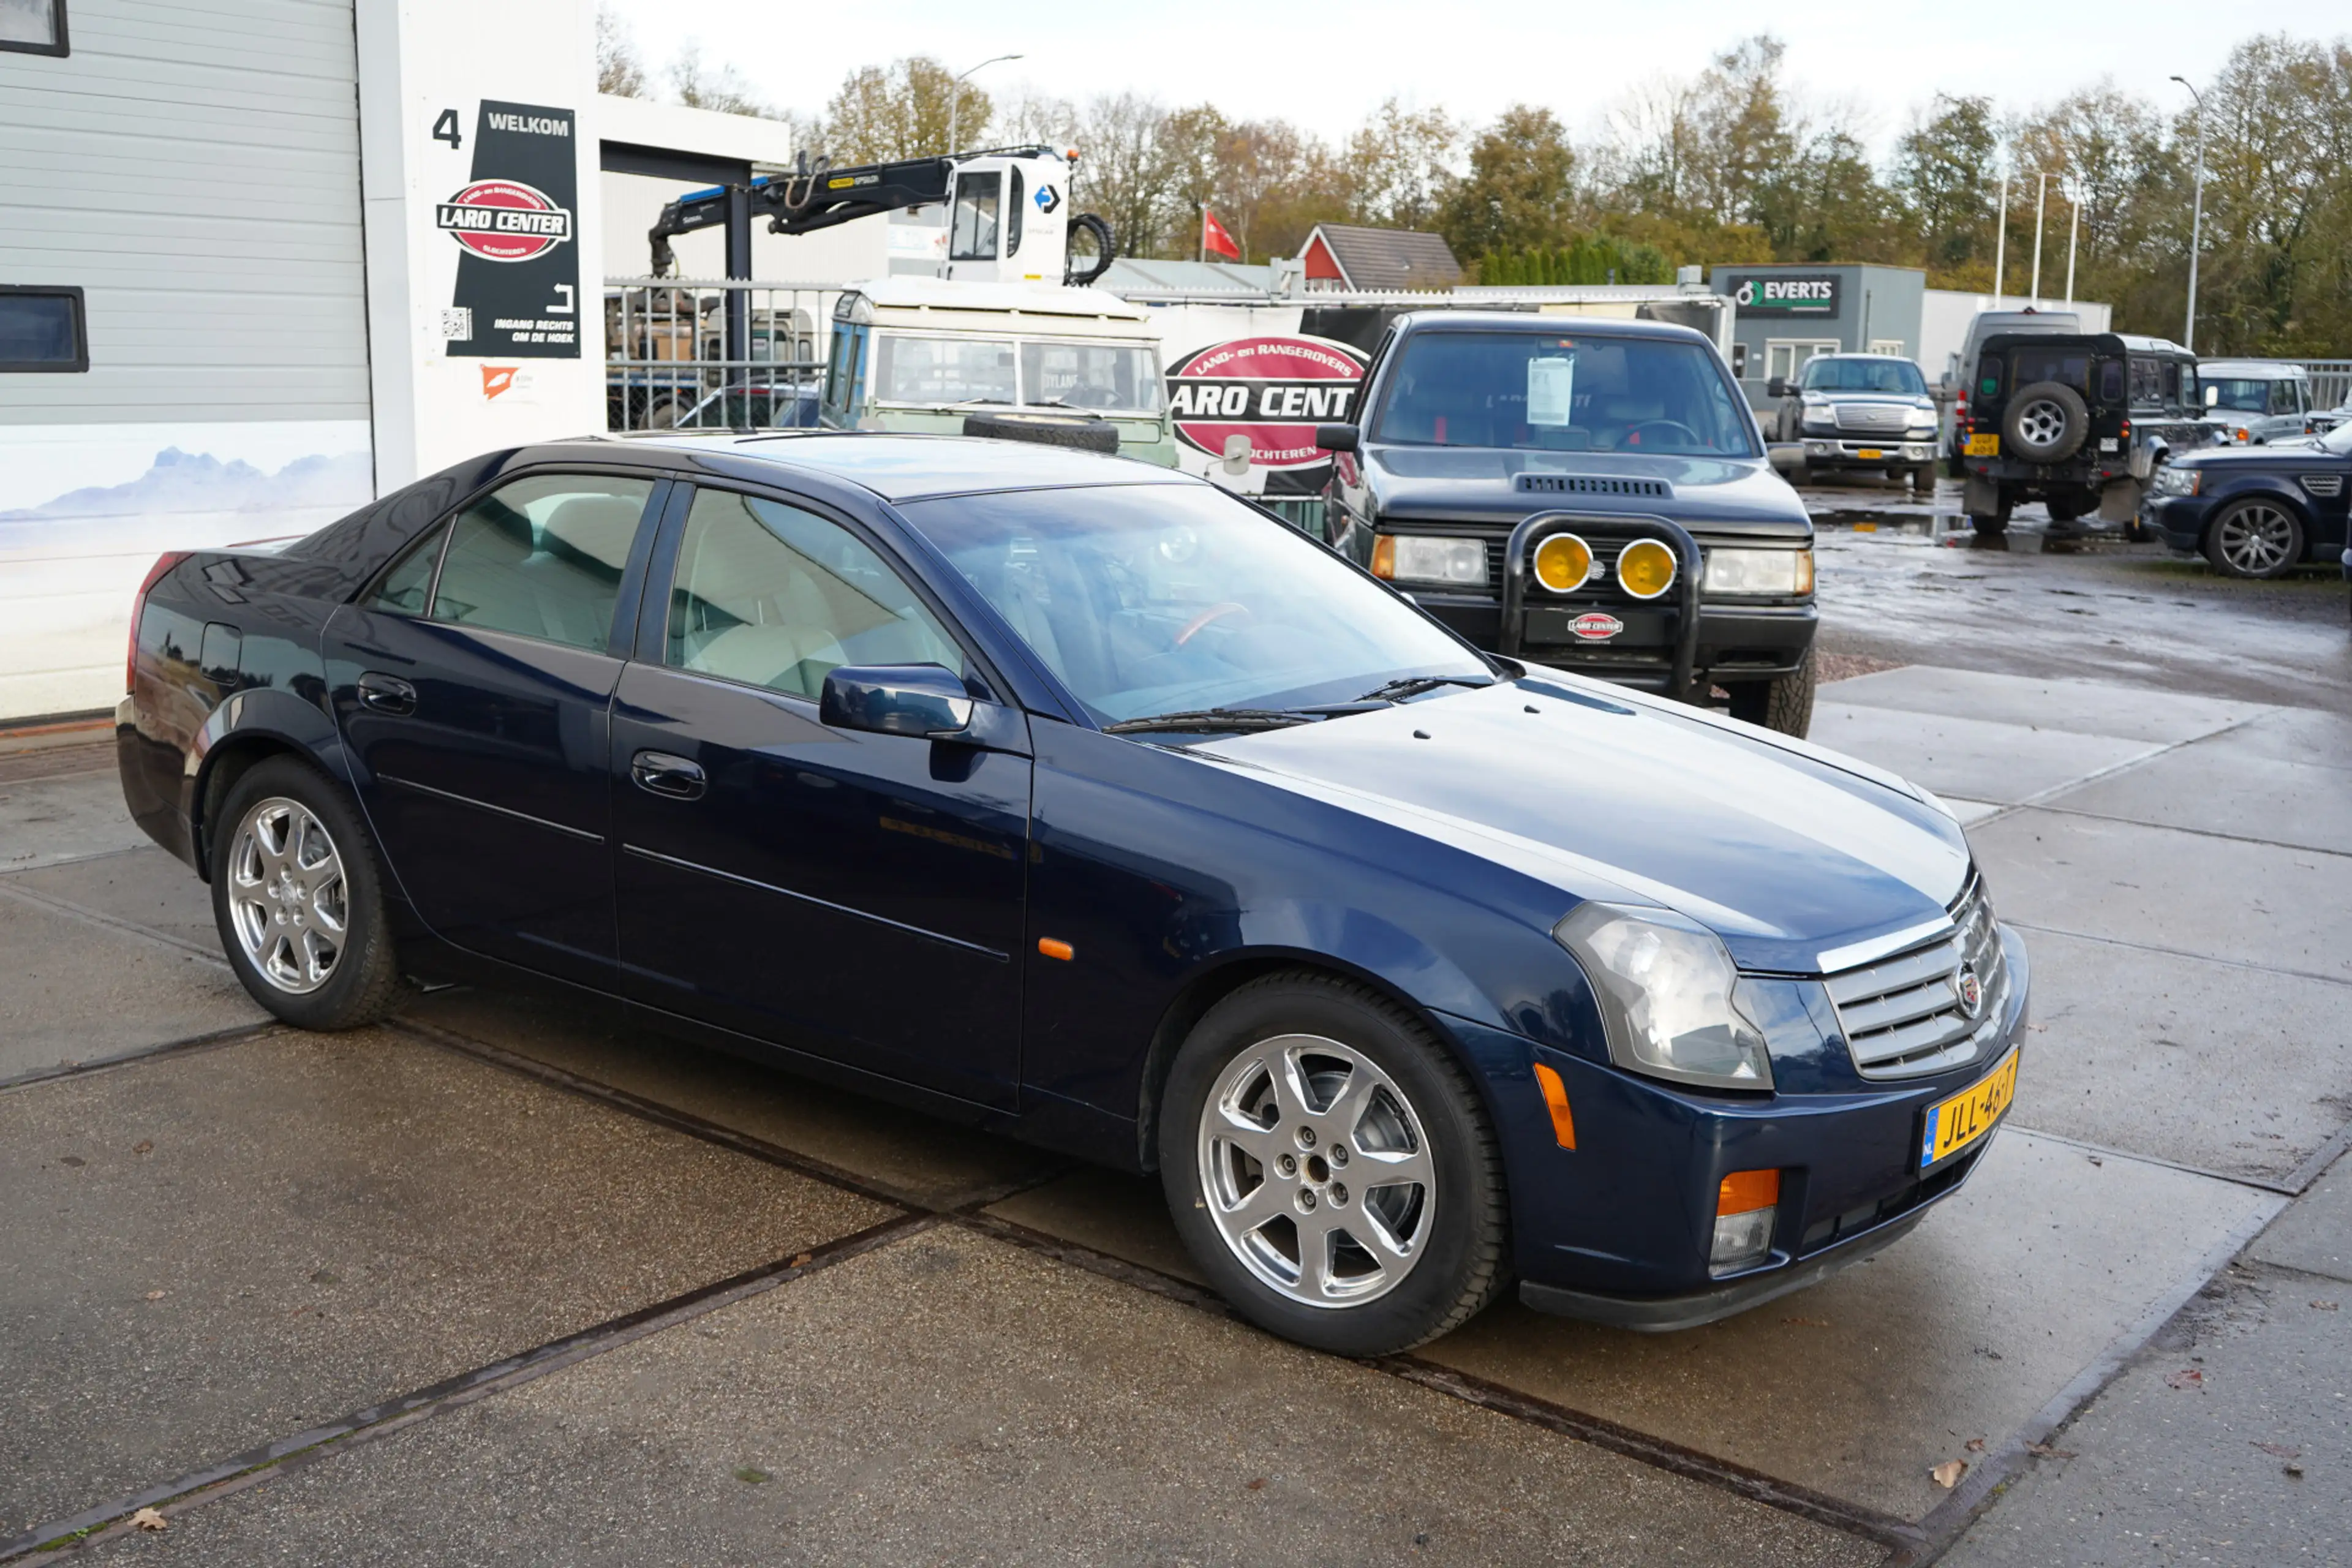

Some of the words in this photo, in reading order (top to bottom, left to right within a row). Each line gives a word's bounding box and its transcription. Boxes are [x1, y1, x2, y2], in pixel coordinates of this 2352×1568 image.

[432, 108, 461, 149] 4
[488, 112, 569, 137] WELKOM
[440, 208, 492, 228] LARO
[496, 212, 564, 234] CENTER
[1765, 281, 1832, 299] EVERTS
[494, 318, 534, 330] INGANG
[535, 320, 574, 331] RECHTS
[512, 332, 529, 342] OM
[531, 333, 545, 343] DE
[547, 333, 575, 343] HOEK
[1195, 351, 1235, 375] LAND-
[1237, 347, 1254, 358] en
[1257, 344, 1354, 378] RANGEROVERS
[1169, 385, 1250, 415] ARO
[1259, 386, 1356, 417] CENT
[1250, 445, 1317, 460] OCHTEREN
[1922, 1143, 1932, 1157] NL
